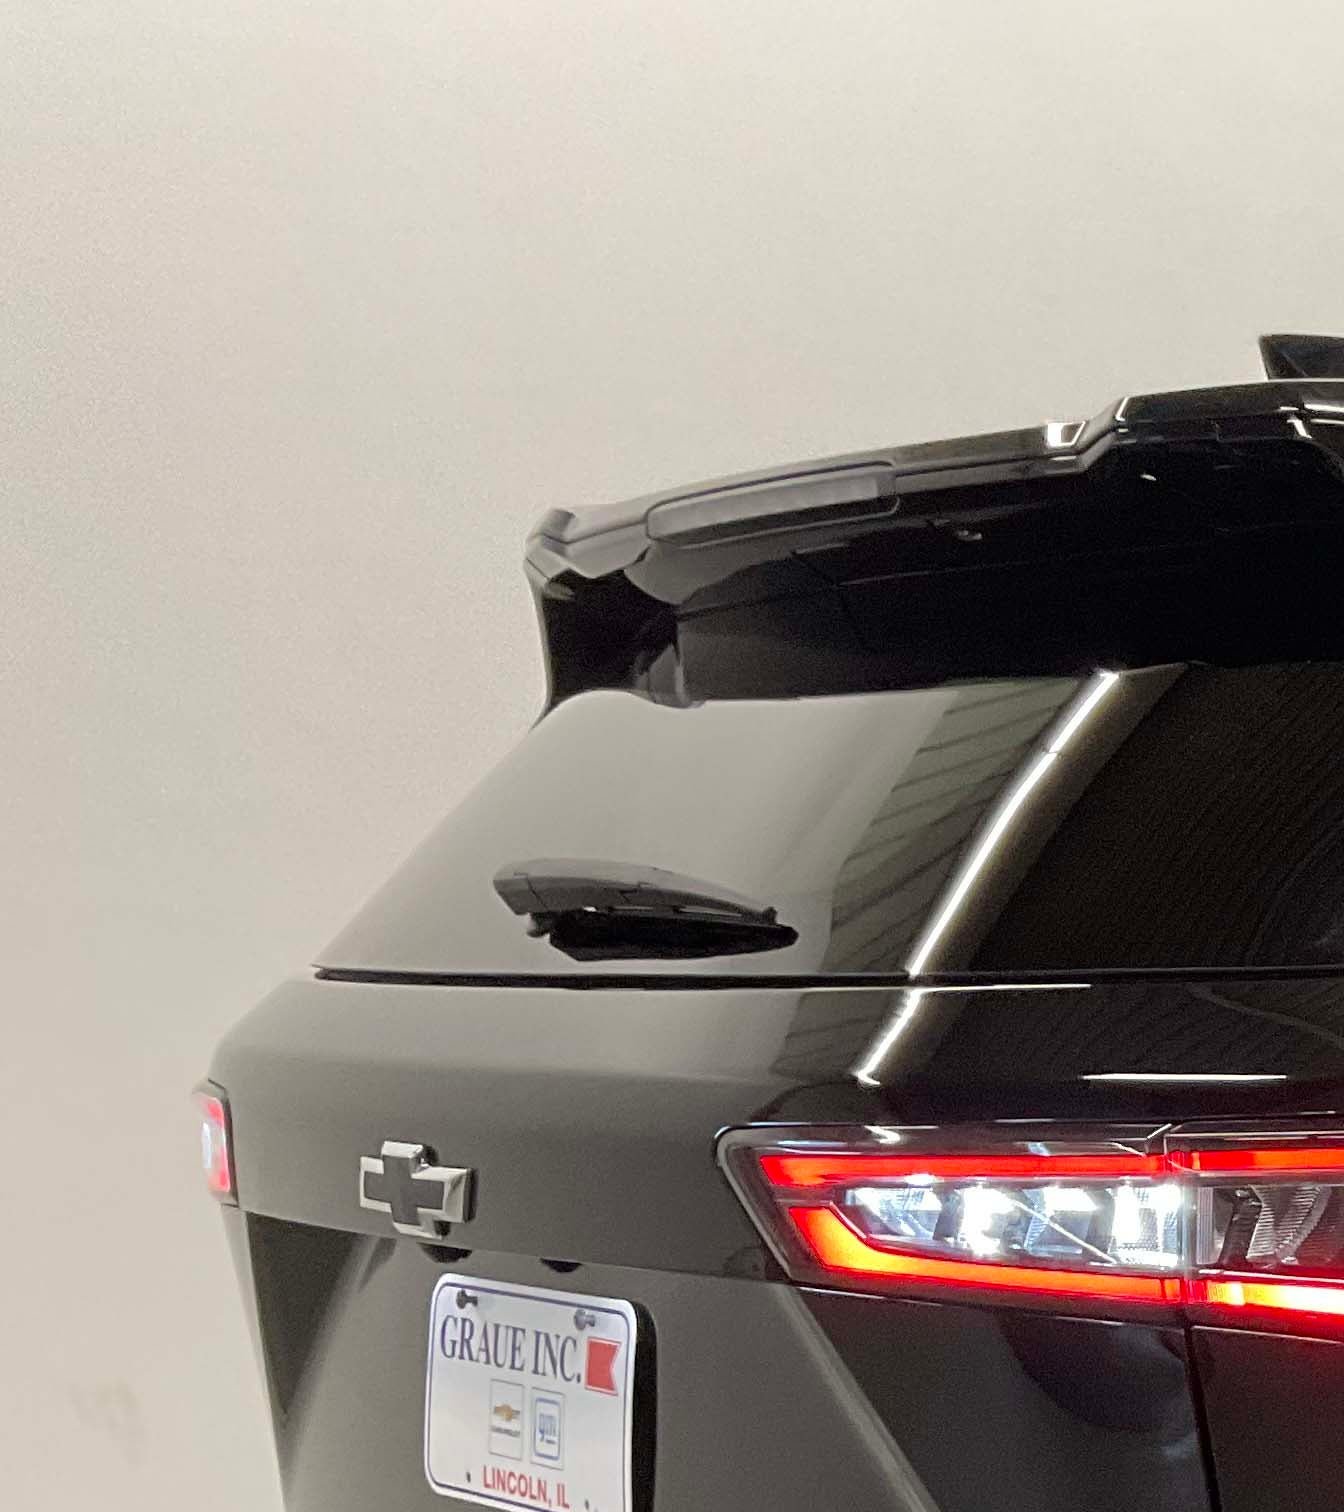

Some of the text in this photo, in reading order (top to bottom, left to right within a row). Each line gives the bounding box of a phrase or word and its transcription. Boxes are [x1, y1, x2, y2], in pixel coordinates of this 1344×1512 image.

[440, 1314, 582, 1384] GRAUE INC.
[482, 1465, 570, 1509] LINCOLN, IL
